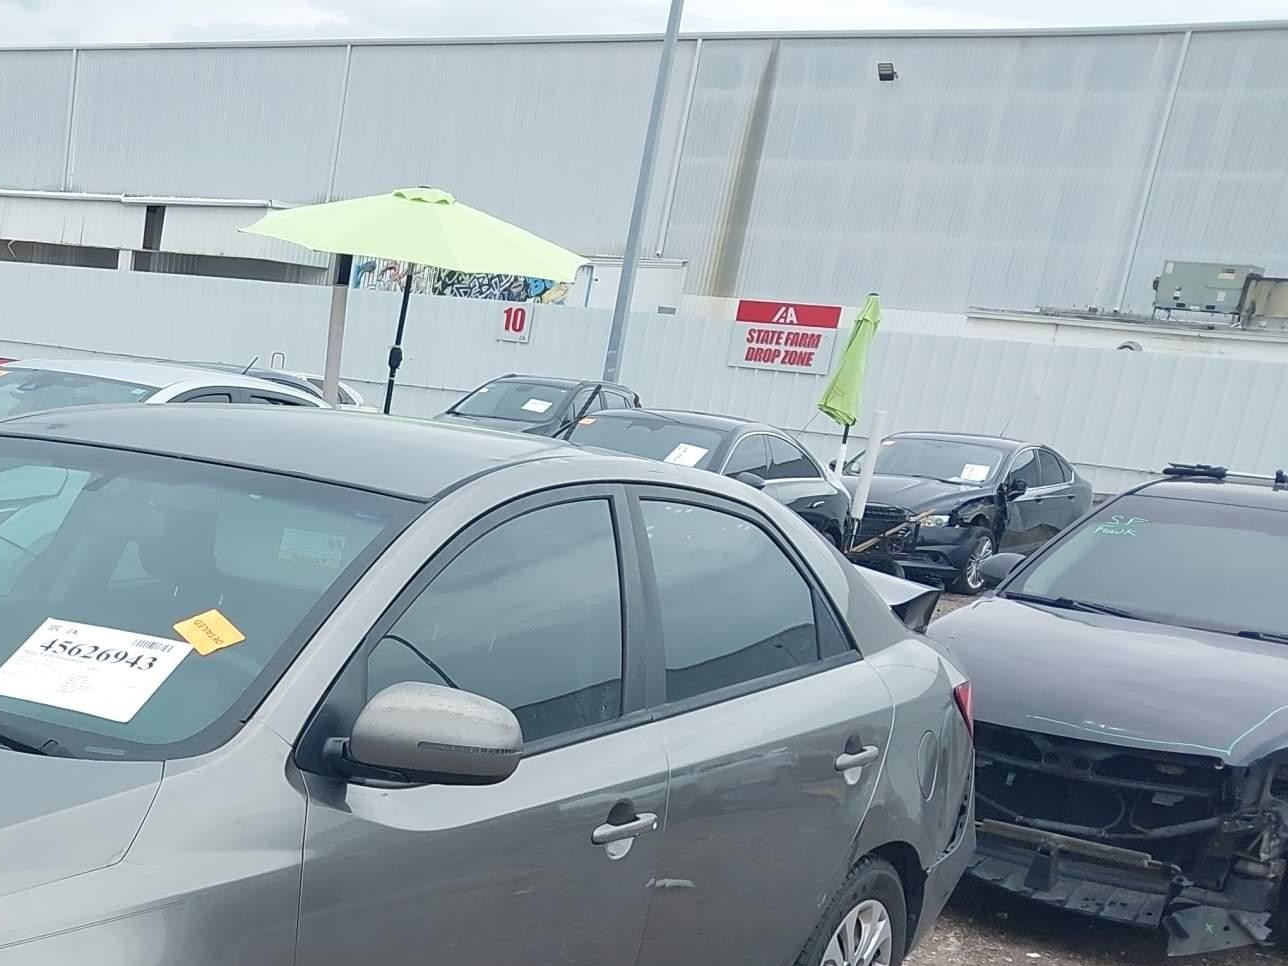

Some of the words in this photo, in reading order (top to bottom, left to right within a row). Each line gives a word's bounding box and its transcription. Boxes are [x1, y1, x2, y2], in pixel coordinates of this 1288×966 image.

[504, 307, 526, 332] 10
[746, 328, 785, 346] STATE
[784, 332, 822, 349] FARM
[745, 347, 781, 364] DROP
[780, 350, 815, 367] ZONE
[194, 619, 225, 645] DETAILED
[40, 638, 158, 671] 45626943
